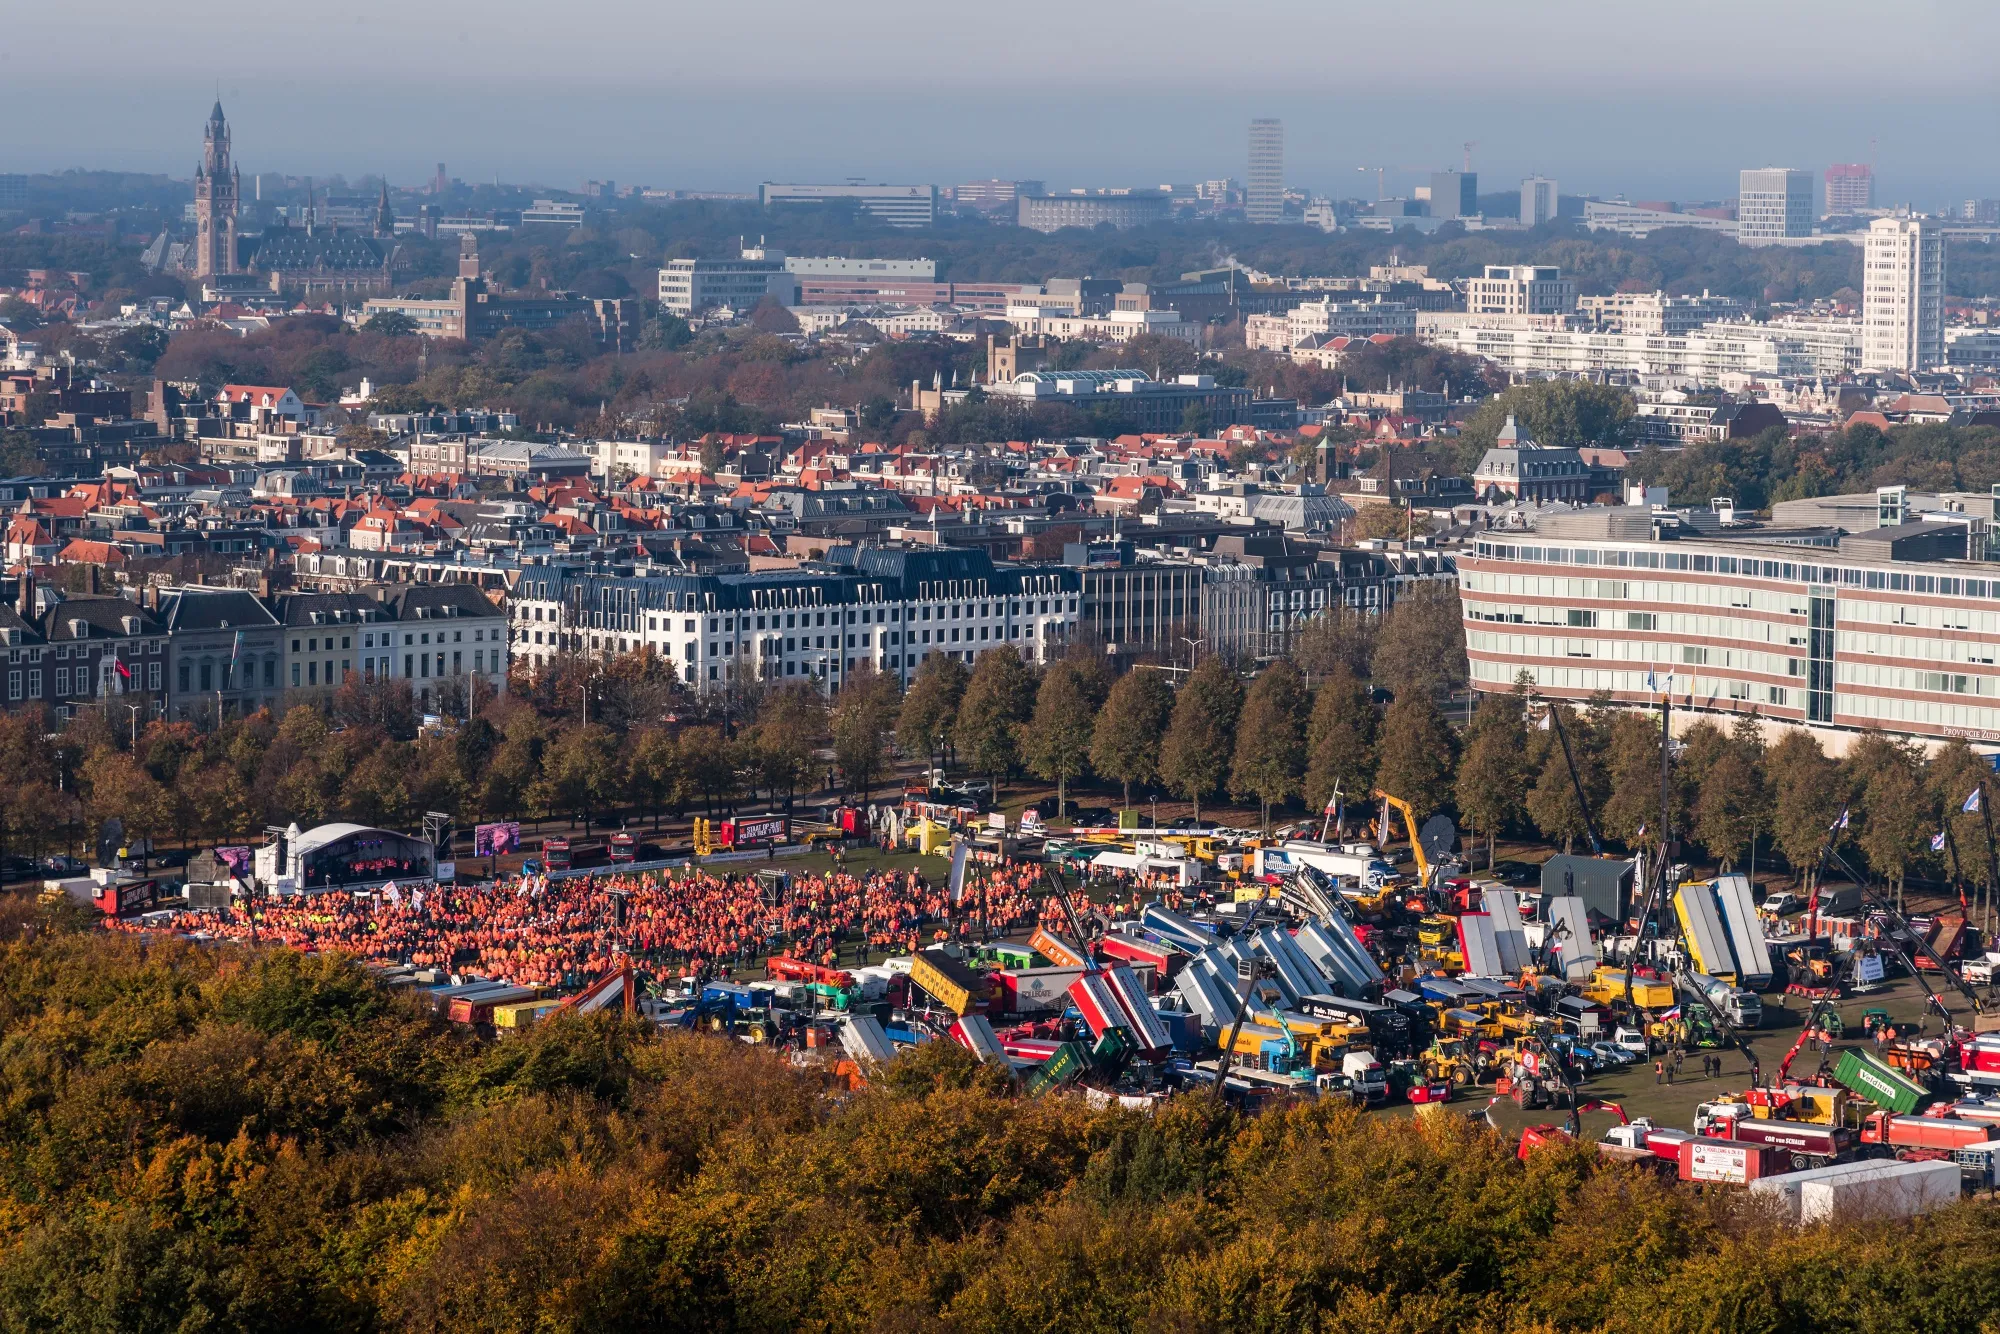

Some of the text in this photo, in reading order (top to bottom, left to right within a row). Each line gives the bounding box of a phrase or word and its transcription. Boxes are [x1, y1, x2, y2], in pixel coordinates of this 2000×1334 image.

[1943, 726, 1980, 738] PROVINCIE
[1327, 1008, 1348, 1019] TROOST
[1862, 1071, 1894, 1097] Veldhuis
